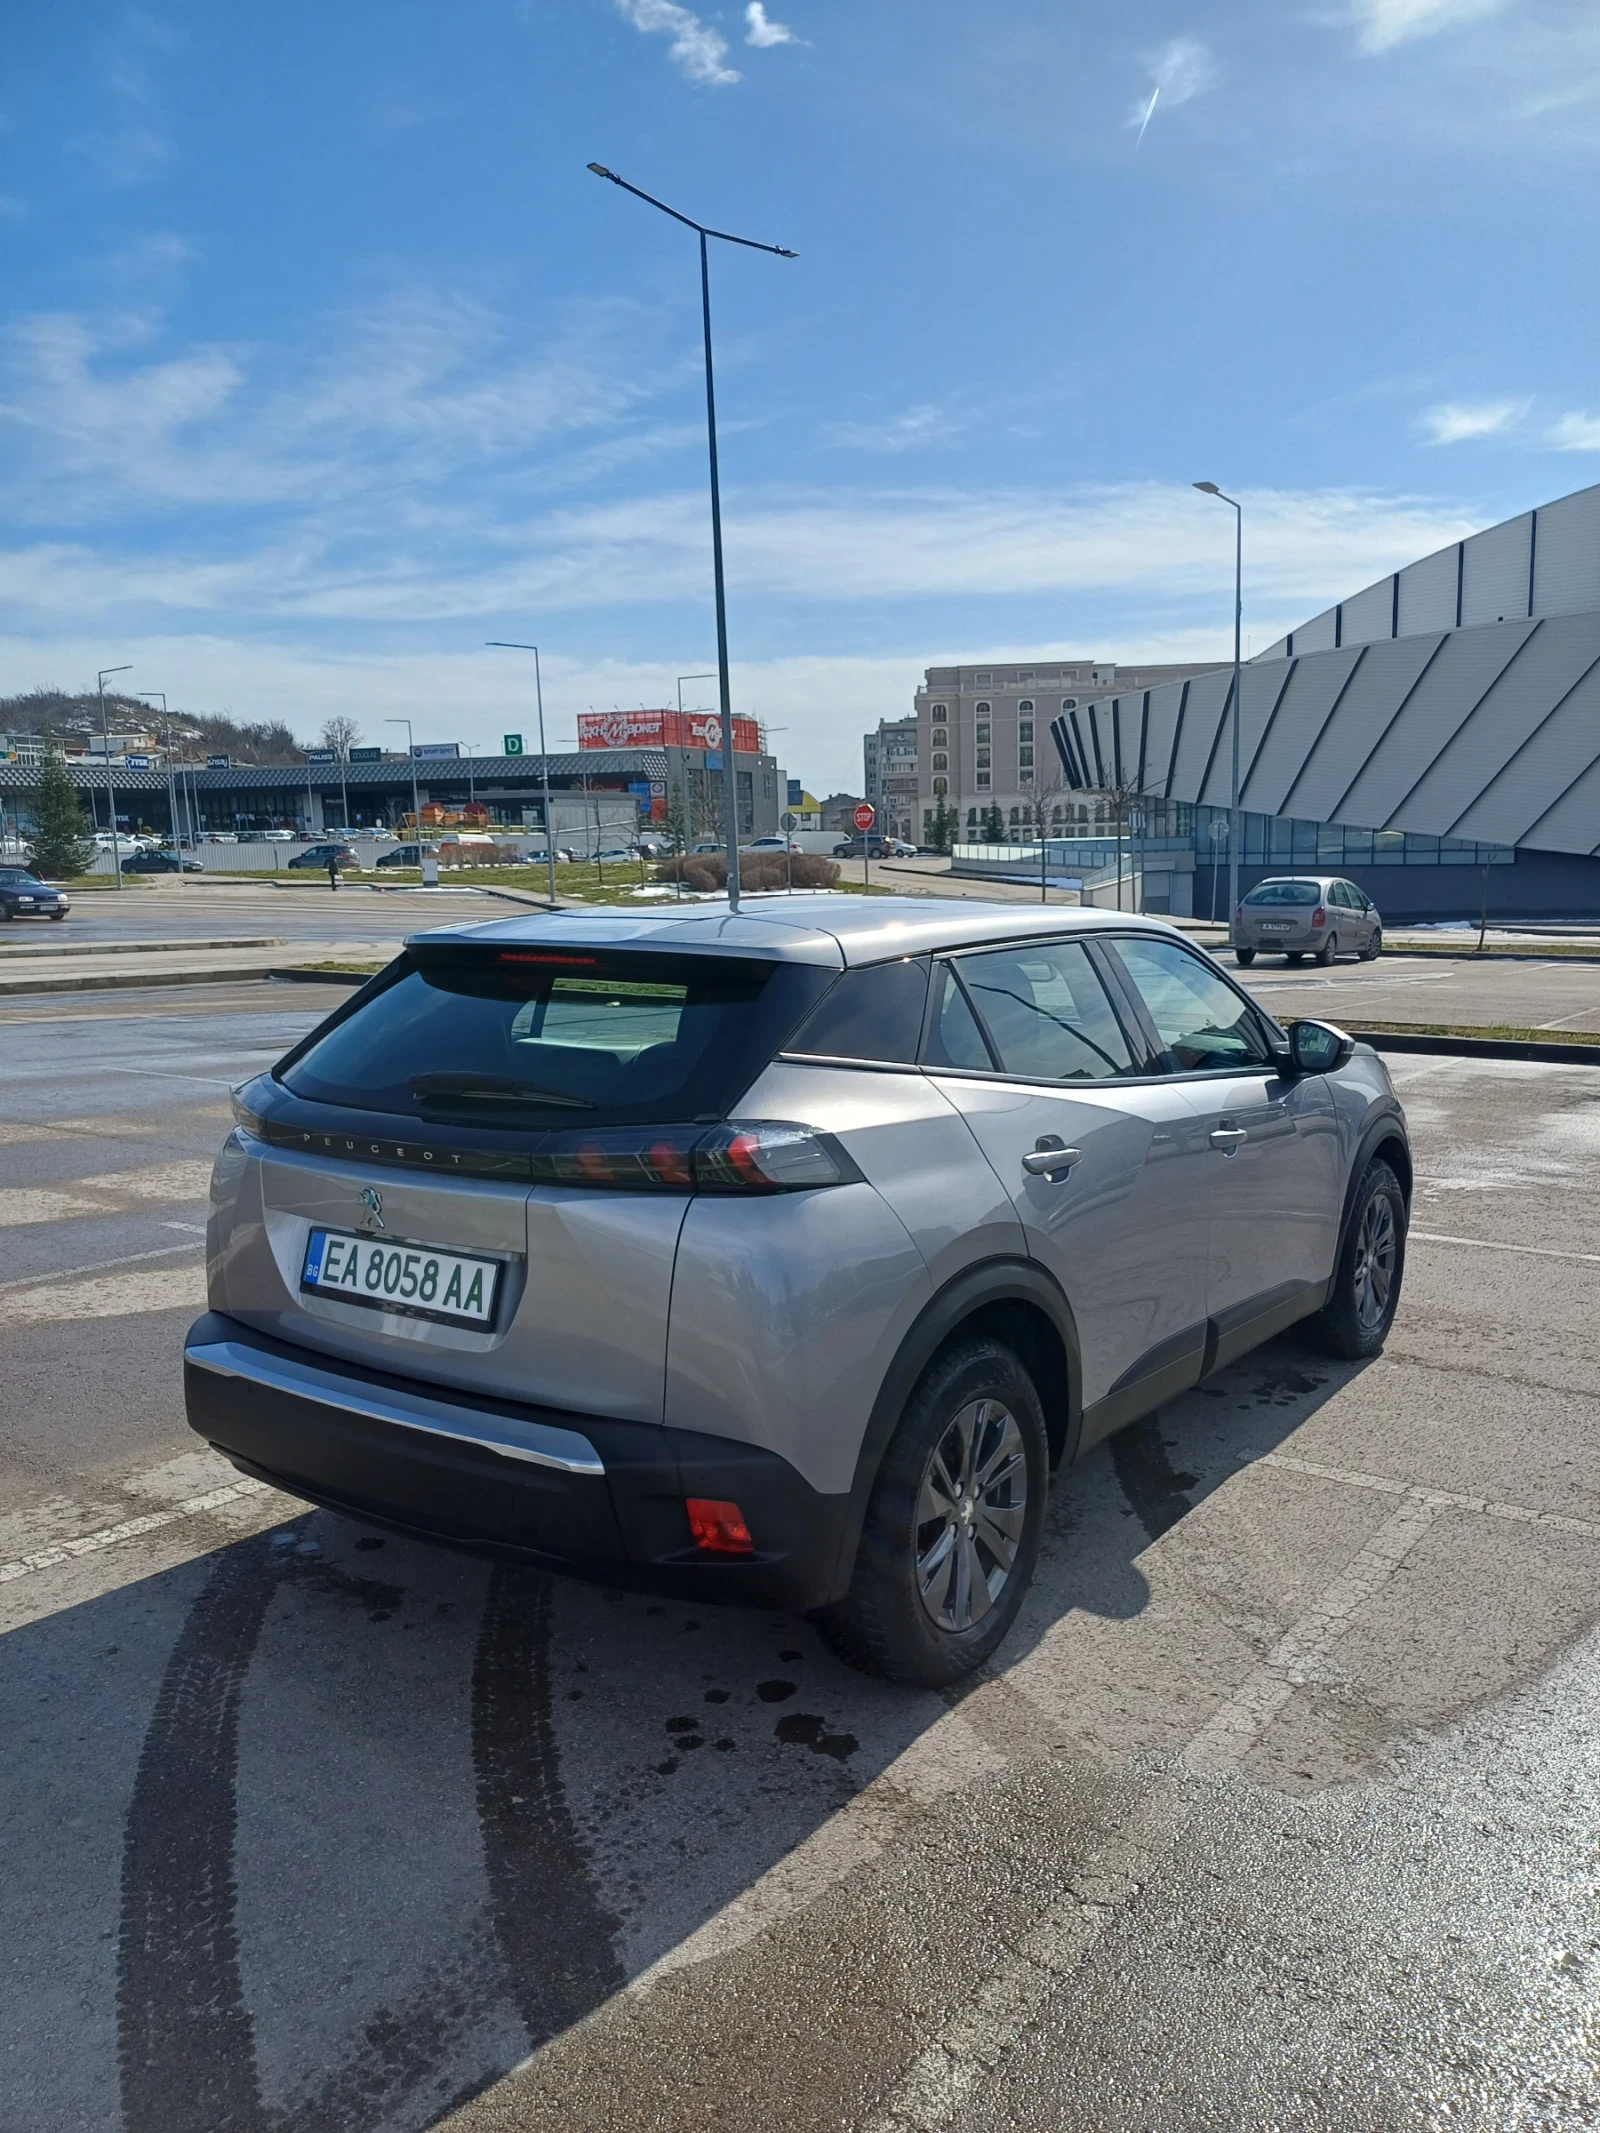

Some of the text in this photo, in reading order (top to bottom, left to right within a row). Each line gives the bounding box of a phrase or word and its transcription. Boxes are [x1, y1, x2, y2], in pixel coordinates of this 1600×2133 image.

[507, 738, 520, 751] D
[352, 751, 377, 759] DOUGLAS
[856, 812, 872, 822] STOP
[303, 1133, 461, 1164] PEUGEOT
[306, 1262, 319, 1278] BG
[322, 1239, 483, 1314] EA 8058 AA
